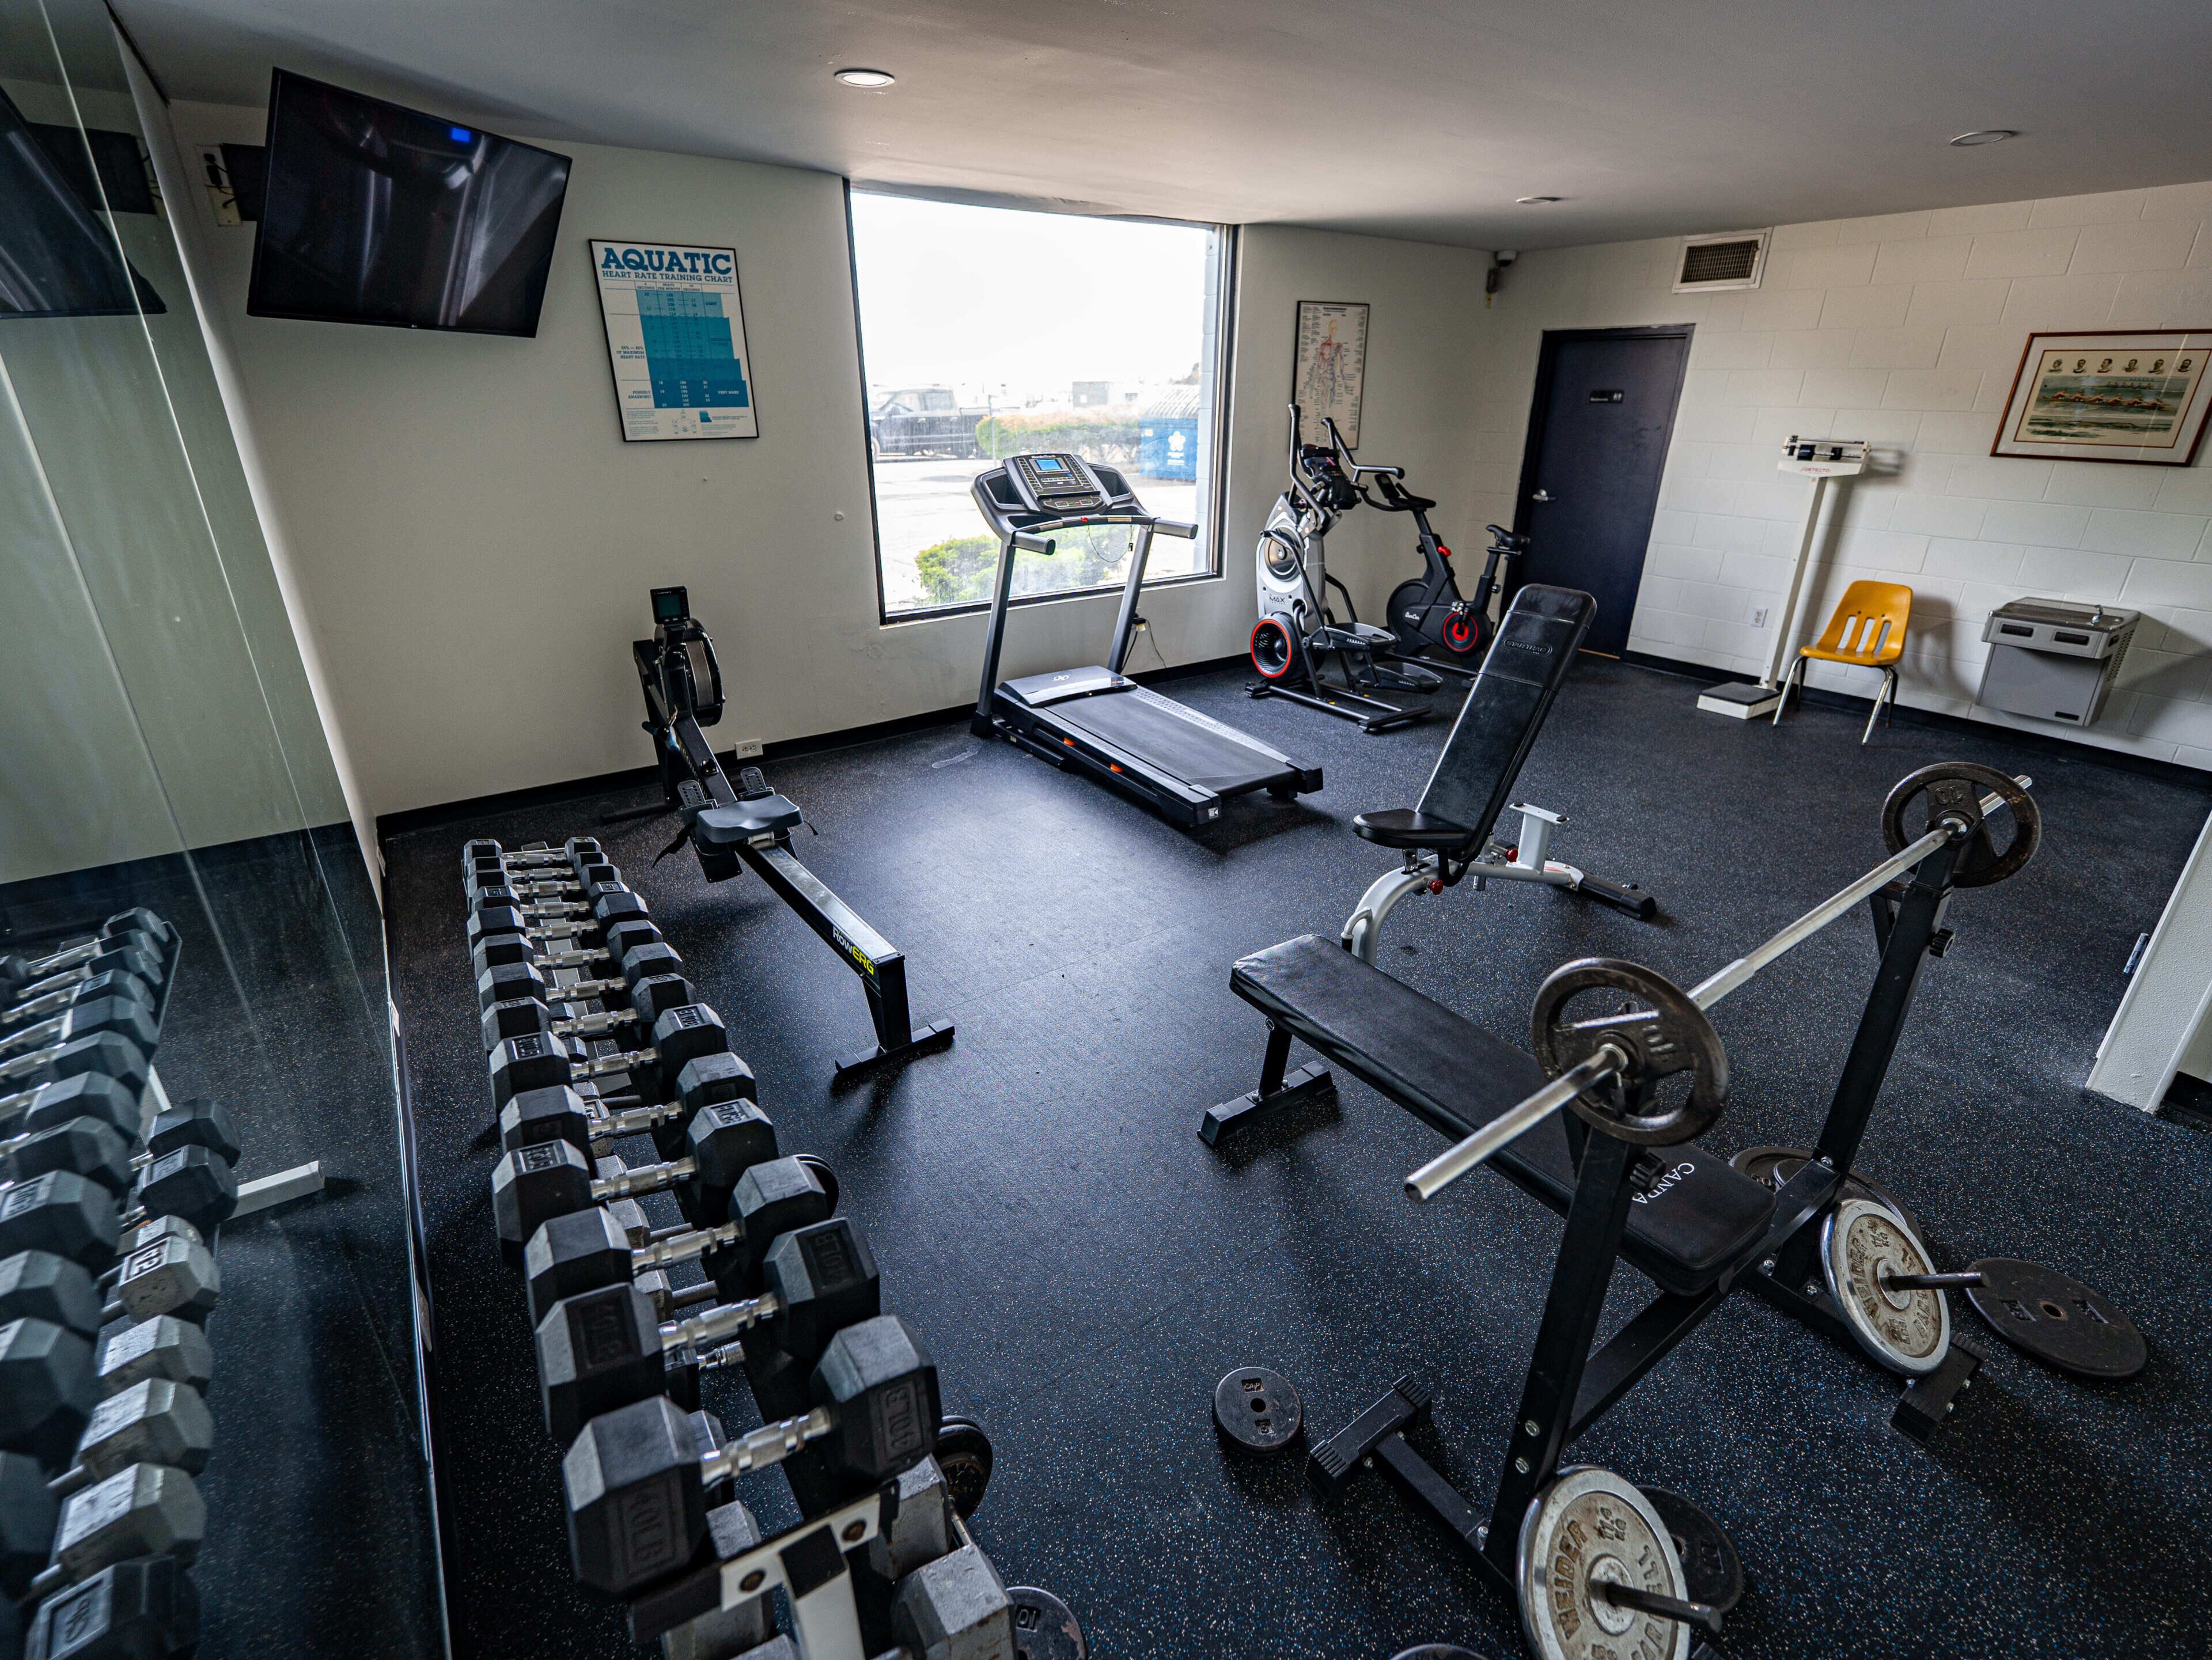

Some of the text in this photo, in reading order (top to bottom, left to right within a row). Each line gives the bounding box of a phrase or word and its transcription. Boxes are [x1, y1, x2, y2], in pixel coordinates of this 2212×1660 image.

[601, 247, 732, 275] AQUATIC
[603, 270, 631, 279] HEART
[659, 273, 702, 282] TRAINING
[1631, 1162, 1696, 1205] CANDA
[1850, 1237, 1880, 1320] WEIDER
[1554, 1519, 1588, 1641] WEIDER
